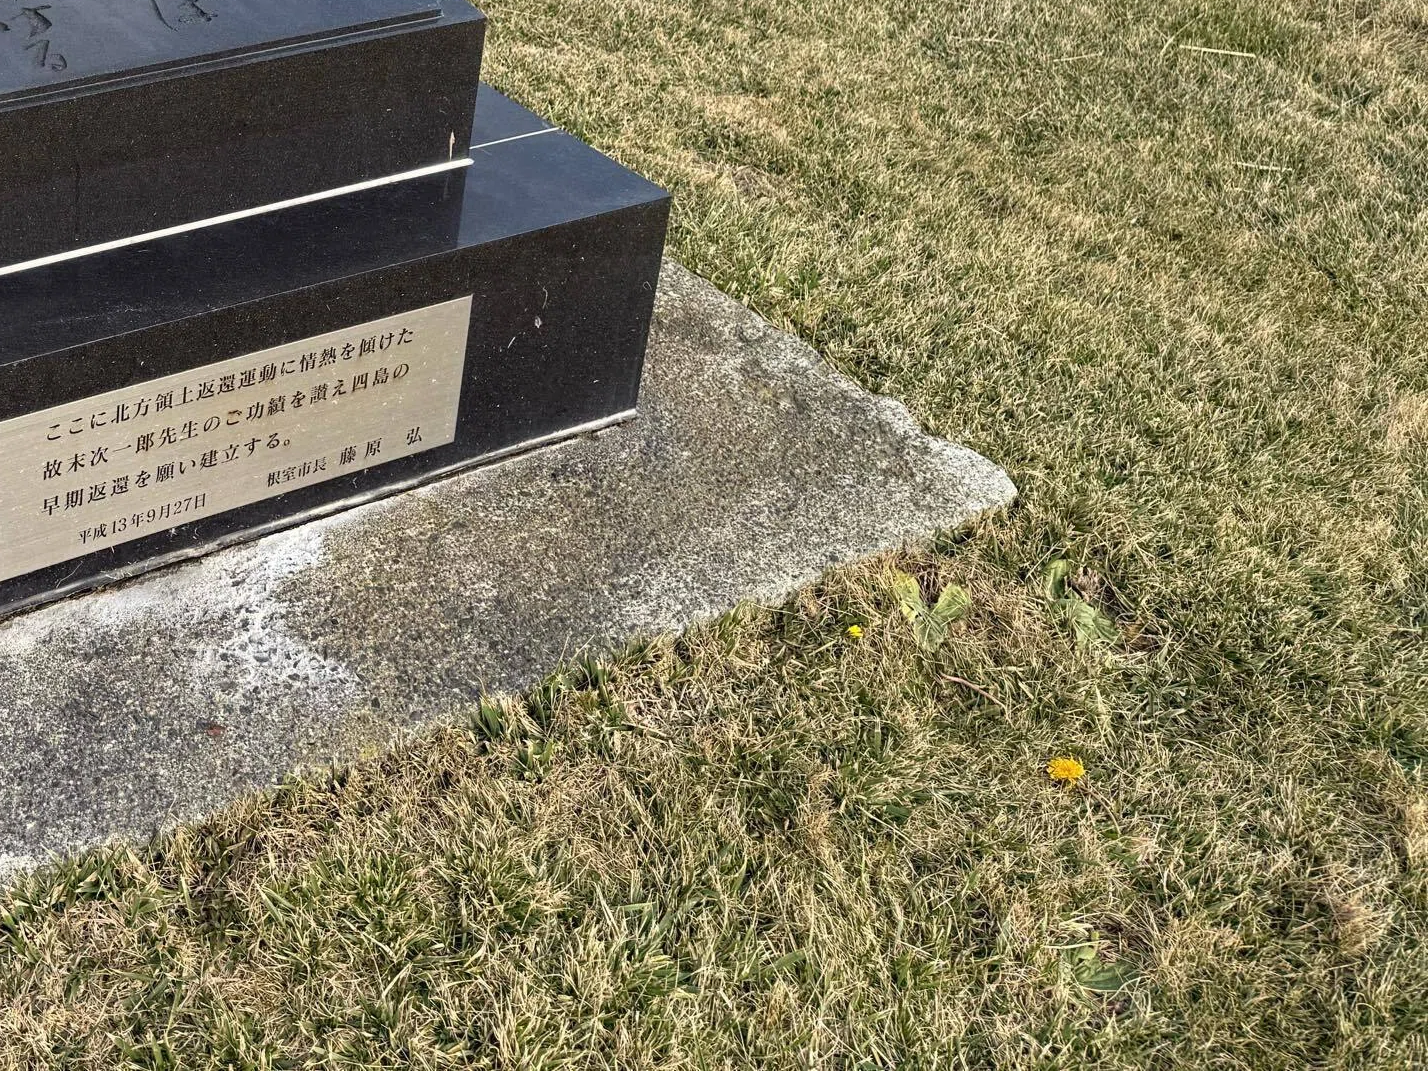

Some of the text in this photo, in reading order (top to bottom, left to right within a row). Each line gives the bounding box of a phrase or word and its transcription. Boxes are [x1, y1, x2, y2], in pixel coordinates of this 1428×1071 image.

[46, 327, 414, 442] ここに北方領土返還運動に情熱を傾けた
[41, 433, 291, 516] 早期返還を願い建立する。
[78, 492, 207, 544] 平成13年9月27日
[267, 456, 327, 487] 根室市長
